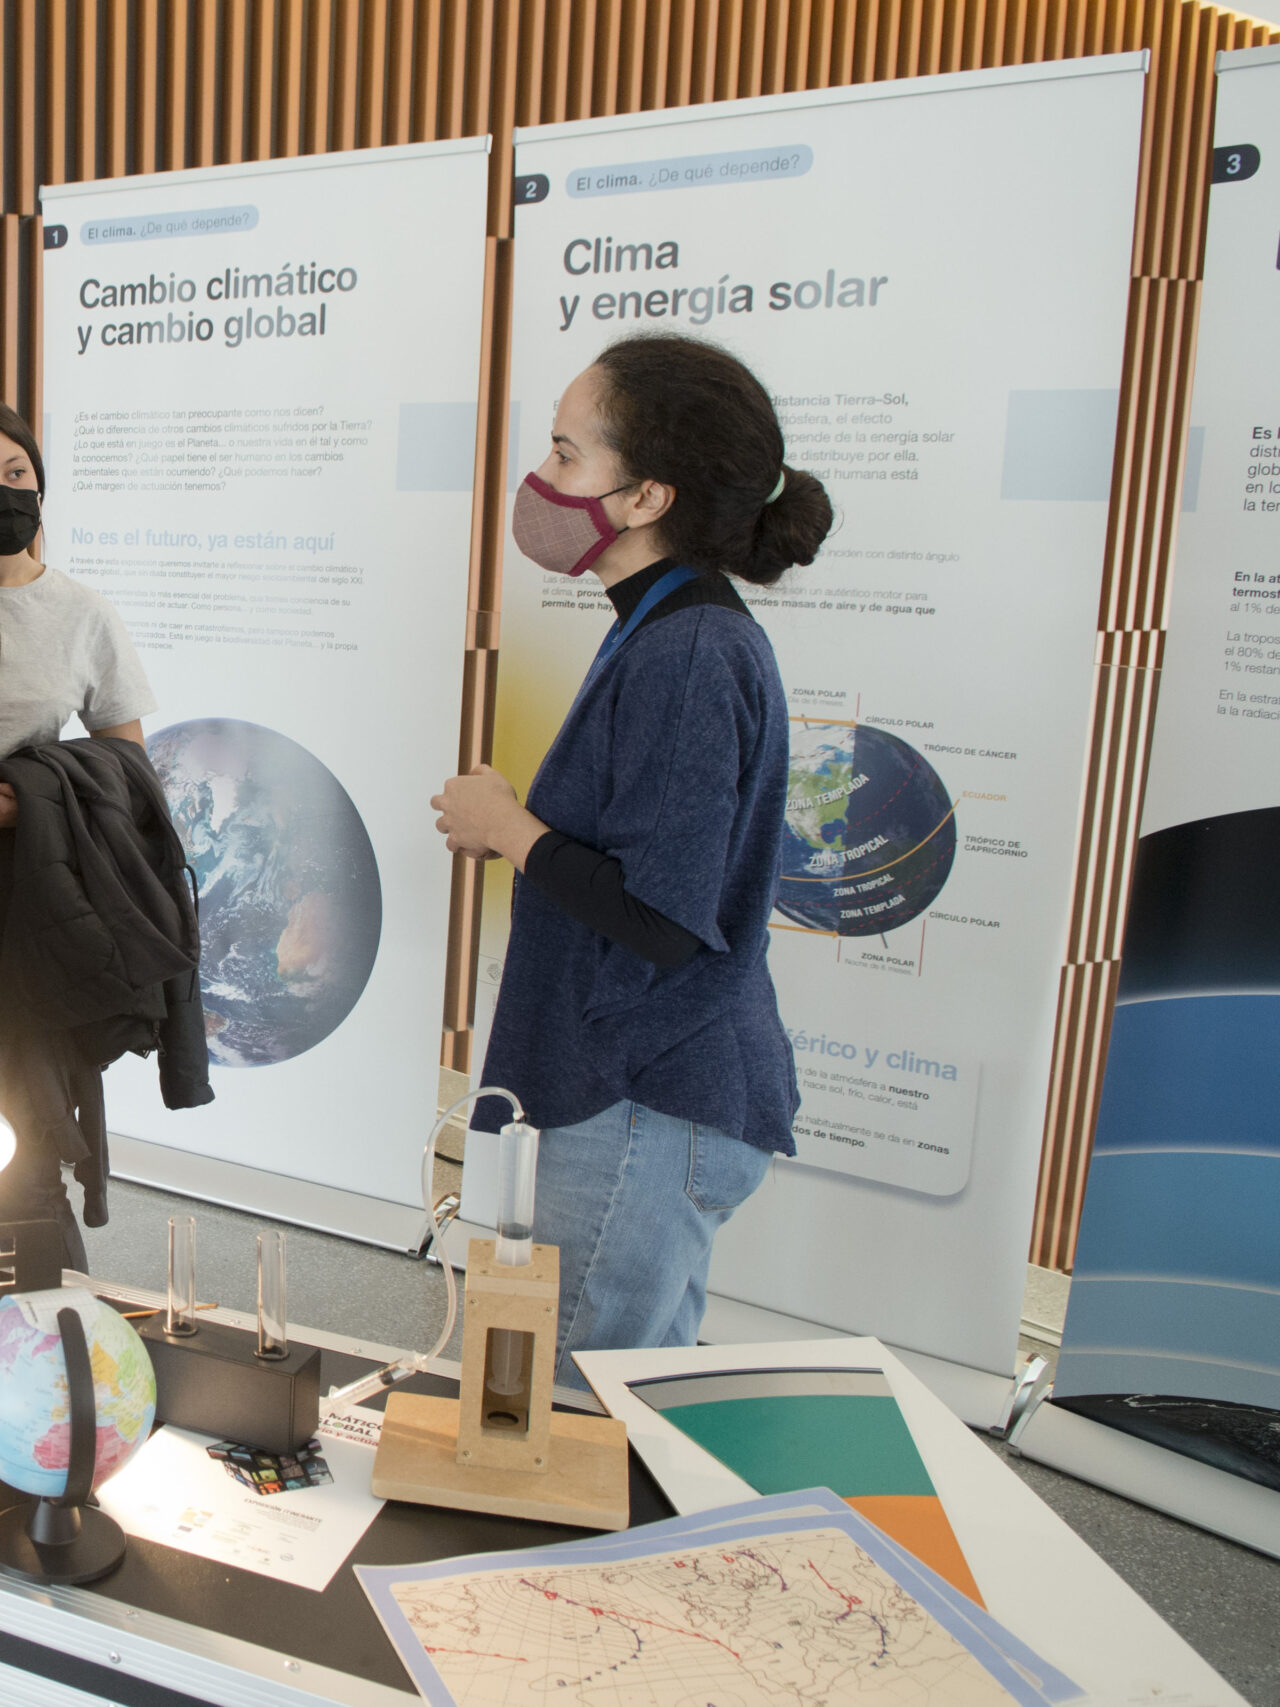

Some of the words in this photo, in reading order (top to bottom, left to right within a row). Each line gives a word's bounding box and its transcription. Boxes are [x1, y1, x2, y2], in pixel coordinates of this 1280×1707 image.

[1226, 153, 1241, 174] 3
[576, 176, 591, 191] El
[595, 172, 643, 190] clima.
[648, 167, 680, 188] ¿De
[684, 163, 713, 182] qué
[719, 153, 801, 178] depende?
[525, 180, 538, 198] 2
[88, 227, 99, 241] El
[102, 224, 137, 240] clima.
[140, 220, 163, 239] ¿De
[166, 217, 188, 235] qué
[191, 211, 251, 232] depende?
[52, 229, 60, 245] 1
[562, 236, 680, 276] Clima
[79, 271, 197, 309] Cambio
[206, 261, 358, 301] climático
[559, 294, 580, 332] y
[591, 273, 754, 326] energía
[768, 268, 890, 312] solar
[77, 324, 93, 356] y
[100, 311, 214, 346] cambio
[223, 302, 327, 349] global
[771, 394, 831, 407] distancia
[100, 410, 130, 421] cambio
[131, 408, 171, 421] climático
[188, 408, 243, 421] preocupante
[245, 409, 271, 418] como
[293, 405, 325, 418] dicen?
[836, 413, 848, 425] el
[852, 412, 893, 425] efecto
[784, 431, 831, 445] epende
[834, 431, 852, 443] de
[855, 431, 867, 443] la
[870, 430, 919, 446] energía
[922, 430, 955, 443] solar
[1252, 426, 1272, 440] Es
[800, 449, 865, 465] distribuye
[868, 450, 890, 465] por
[893, 449, 920, 462] ella.
[834, 468, 887, 481] humana
[891, 467, 919, 481] está
[94, 482, 126, 494] margen
[184, 481, 227, 492] tenemos?
[1245, 483, 1264, 494] en
[1243, 498, 1256, 512] la
[71, 527, 95, 546] No
[98, 530, 119, 546] es
[124, 528, 140, 546] el
[145, 528, 203, 550] futuro,
[207, 534, 229, 552] ya
[233, 530, 288, 550] están
[293, 531, 336, 555] aquí
[865, 551, 885, 560] con
[886, 550, 924, 562] distinto
[925, 551, 961, 564] ángulo
[1234, 571, 1250, 583] En
[1254, 572, 1265, 583] la
[824, 586, 871, 599] auténtico
[873, 588, 903, 600] motor
[905, 591, 928, 602] para
[542, 599, 577, 609] permite
[578, 601, 595, 611] que
[745, 598, 778, 608] randes
[781, 600, 817, 610] masas
[819, 600, 834, 611] de
[836, 601, 857, 612] aire
[859, 603, 867, 613] y
[869, 602, 883, 613] de
[885, 604, 913, 616] agua
[915, 605, 937, 617] que
[1230, 602, 1241, 612] al
[1244, 602, 1262, 614] 1%
[1226, 631, 1241, 642] La
[1224, 646, 1235, 656] el
[1237, 646, 1264, 659] 80%
[1224, 661, 1242, 673] 1%
[792, 688, 816, 697] ZONA
[818, 690, 847, 699] POLAR
[1219, 689, 1233, 701] En
[1237, 690, 1246, 702] la
[1217, 704, 1226, 715] la
[1229, 705, 1239, 717] la
[905, 720, 935, 730] POLAR
[964, 747, 977, 756] DE
[785, 798, 814, 813] ZONA
[816, 773, 870, 805] TEMPLADA
[962, 790, 1008, 802] ECUADOR
[965, 835, 1003, 847] TRÓPICO
[1004, 841, 1021, 849] DE
[809, 852, 839, 870] ZONA
[841, 834, 890, 864] TROPICAL
[964, 844, 1029, 859] CAPRICORNIO
[833, 886, 856, 898] ZONA
[857, 873, 895, 893] TROPICAL
[840, 908, 863, 920] ZONA
[863, 893, 907, 915] TEMPLADA
[970, 917, 1001, 929] POLAR
[861, 952, 884, 963] ZONA
[886, 955, 915, 968] POLAR
[864, 1046, 880, 1069] y
[885, 1049, 958, 1082] clima
[804, 1066, 818, 1078] de
[819, 1068, 829, 1080] la
[830, 1070, 878, 1090] atmósfera
[888, 1084, 930, 1101] nuestro
[803, 1078, 827, 1093] hace
[828, 1083, 846, 1098] sol,
[867, 1092, 895, 1106] calor,
[897, 1097, 918, 1111] está
[805, 1115, 872, 1138] habitualmente
[873, 1131, 886, 1142] se
[887, 1132, 901, 1144] da
[902, 1136, 916, 1147] en
[917, 1141, 950, 1155] zonas
[813, 1127, 827, 1139] de
